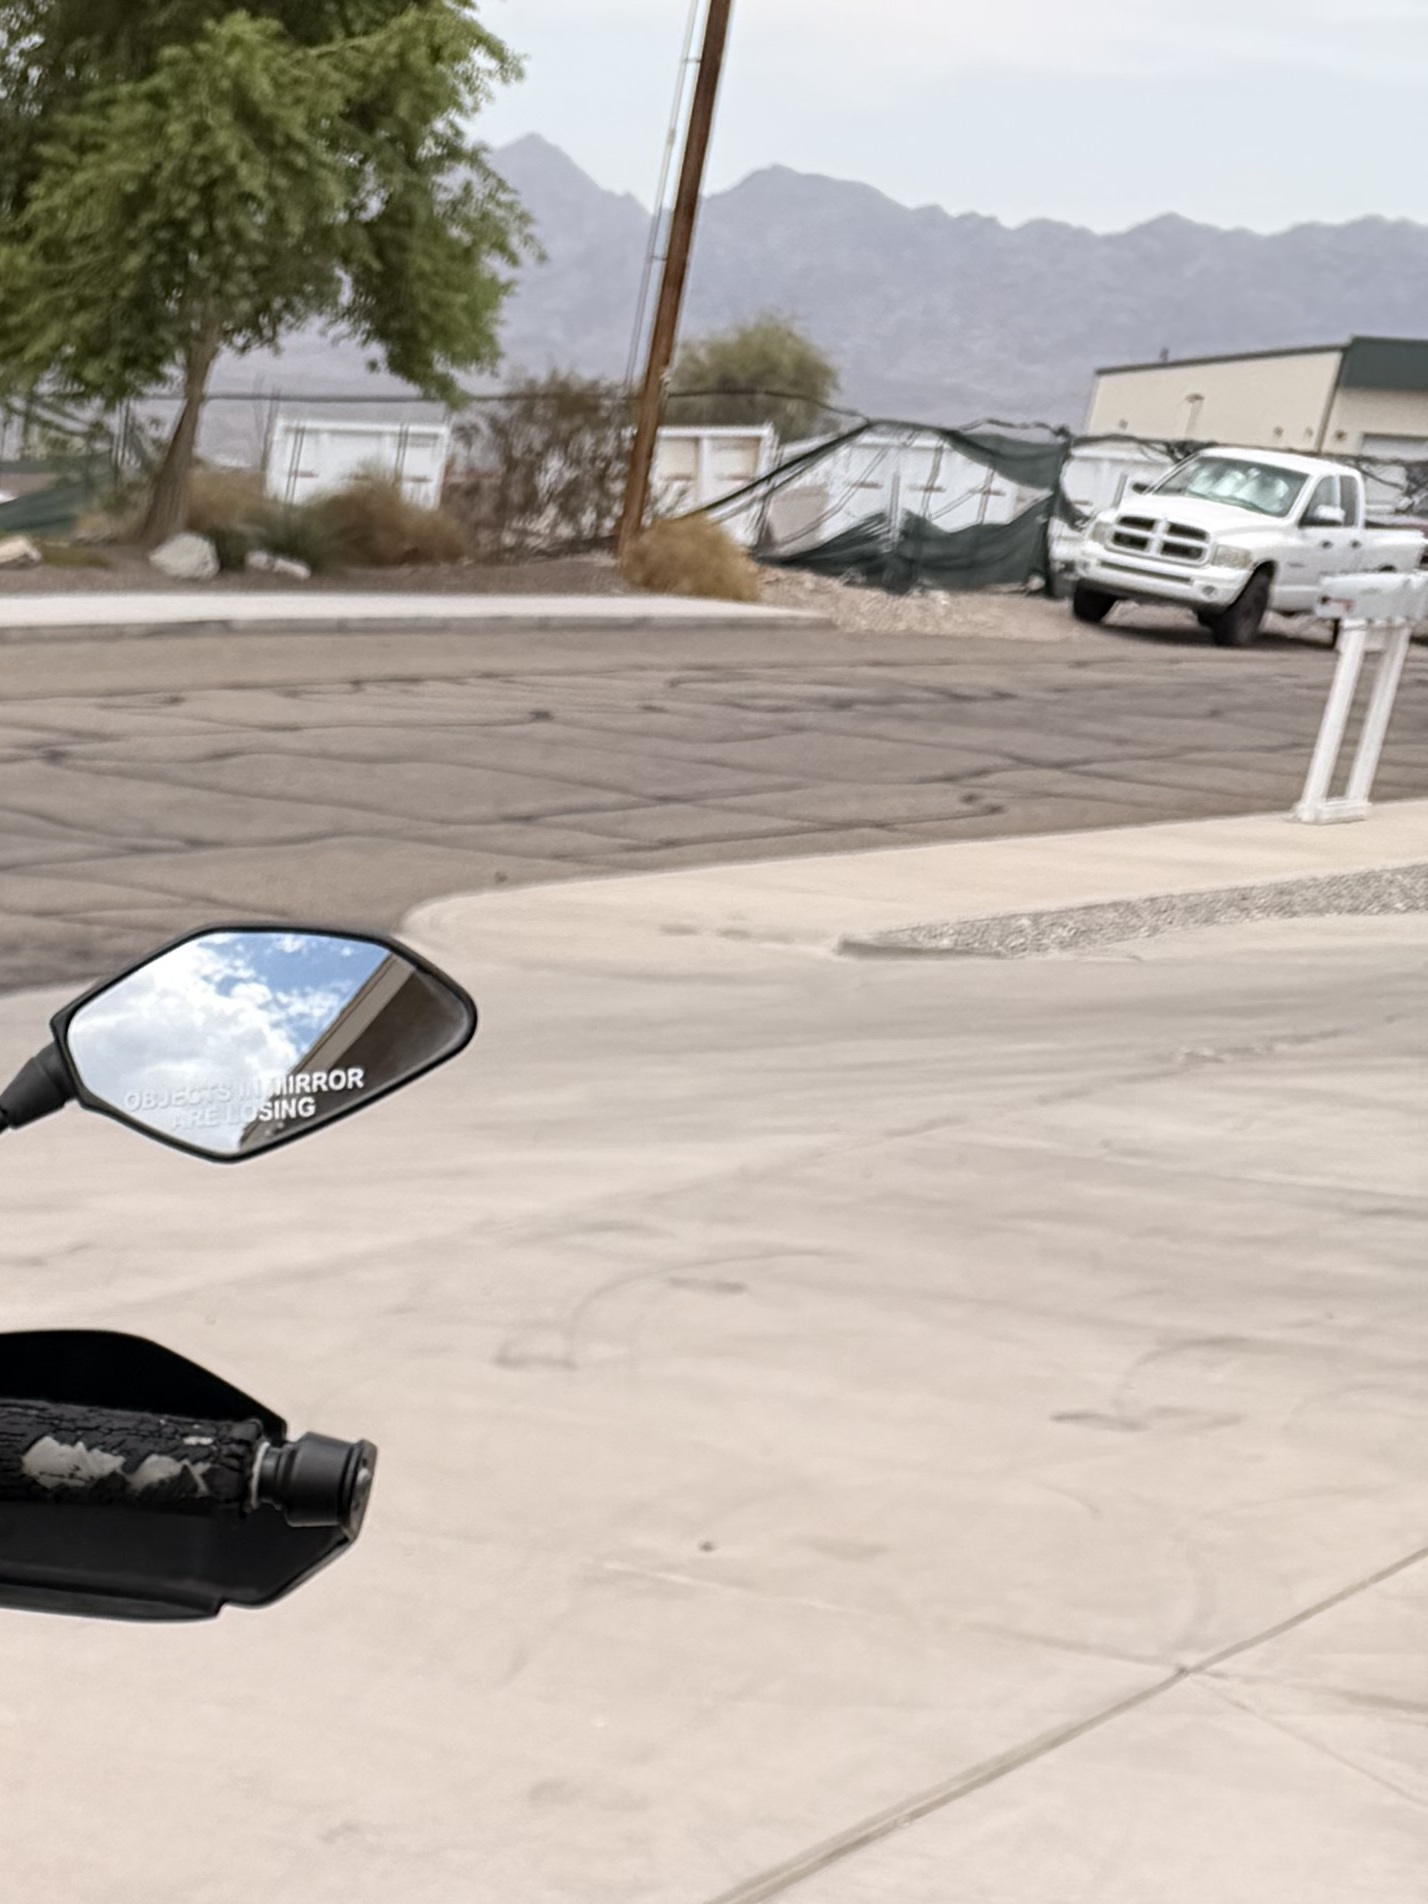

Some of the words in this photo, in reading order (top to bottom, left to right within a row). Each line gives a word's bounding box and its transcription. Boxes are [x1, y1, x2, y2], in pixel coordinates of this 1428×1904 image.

[123, 1084, 231, 1112] OBJECTS
[239, 1080, 263, 1102] IN
[267, 1067, 365, 1096] MIRROR
[170, 1107, 220, 1131] ARE
[227, 1096, 317, 1127] LOSING
